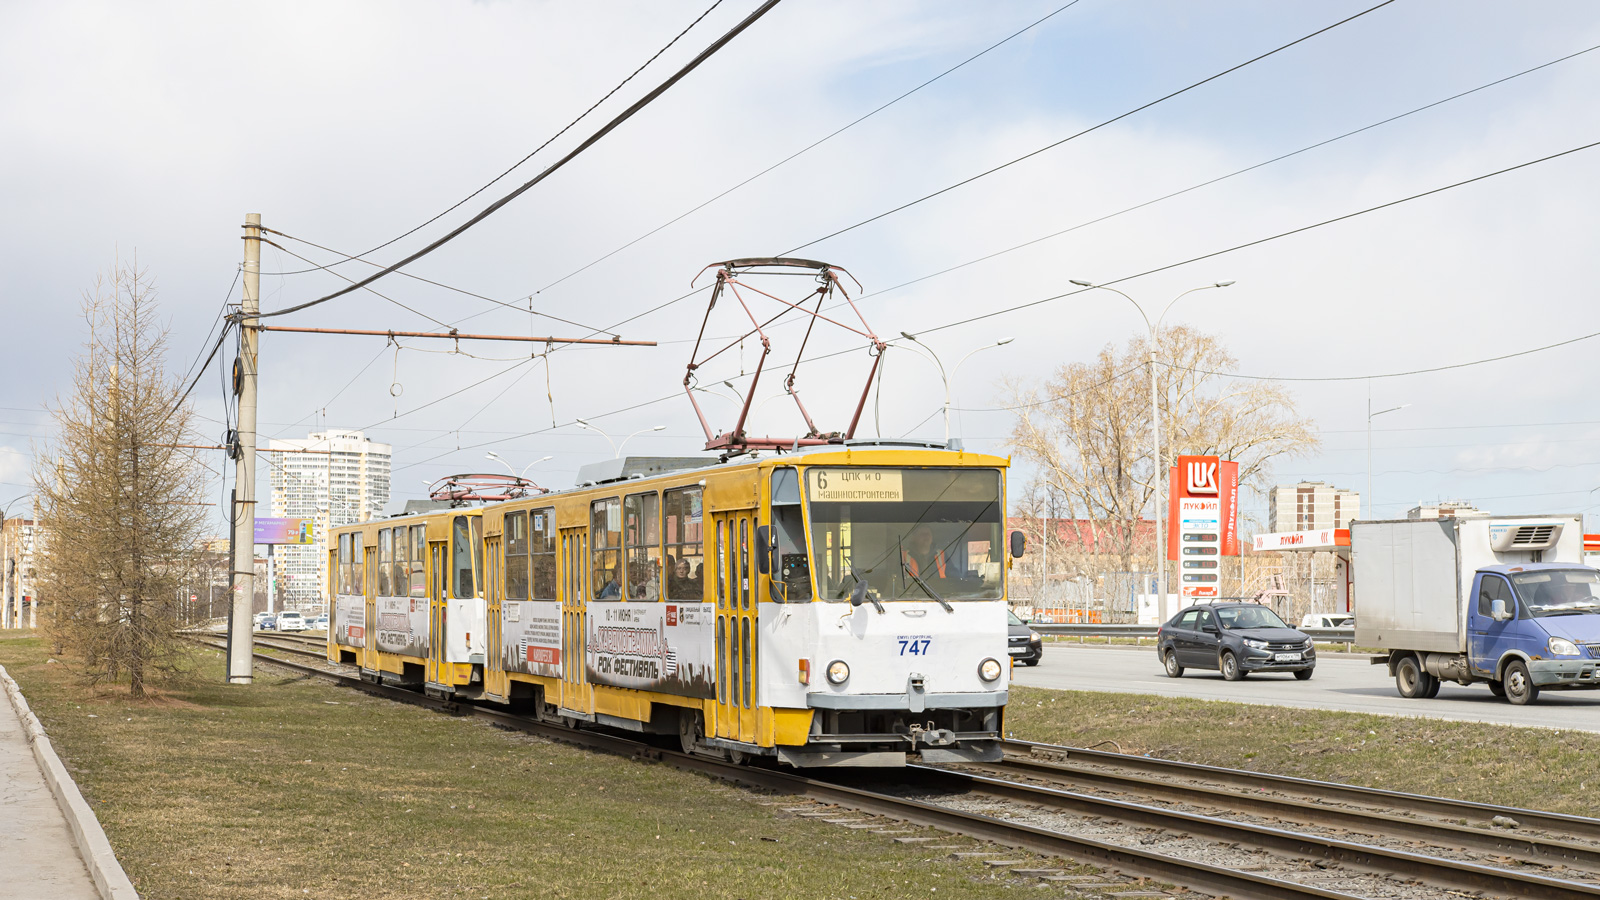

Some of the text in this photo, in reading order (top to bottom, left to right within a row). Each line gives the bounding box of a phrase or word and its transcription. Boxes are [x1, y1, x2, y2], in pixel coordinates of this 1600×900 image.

[817, 471, 828, 489] 6
[842, 472, 861, 482] ЦПК
[1183, 501, 1218, 510] ЛУКОЙЛ
[1280, 533, 1304, 546] ЛУКОЙЛ
[898, 640, 931, 656] 747
[597, 656, 659, 679] РОК ФЕСТИВАЛЬ
